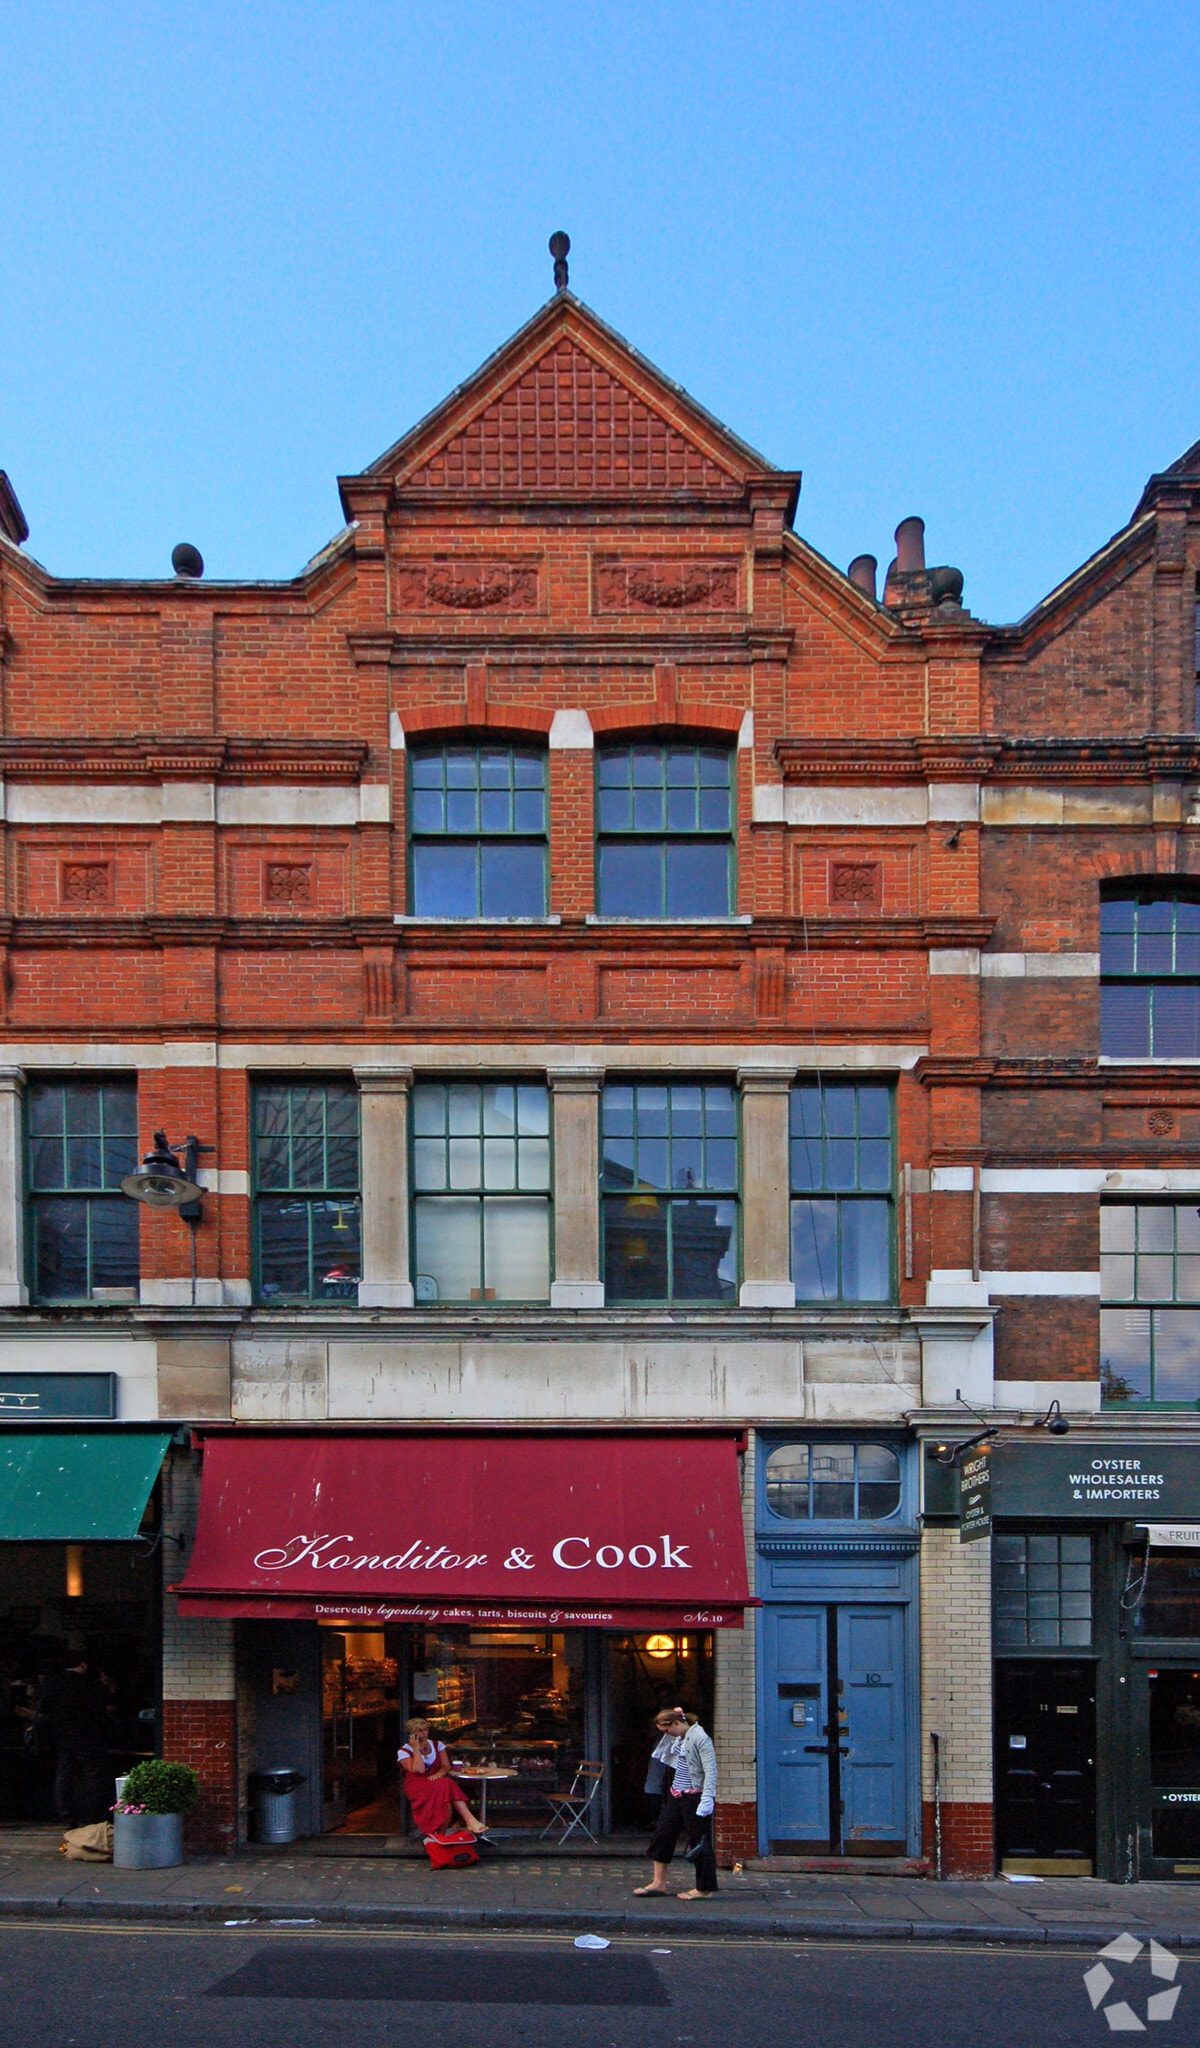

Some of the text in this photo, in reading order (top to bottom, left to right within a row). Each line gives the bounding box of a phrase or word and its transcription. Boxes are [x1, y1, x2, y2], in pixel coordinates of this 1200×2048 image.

[963, 1456, 987, 1476] WRIGHT
[1091, 1460, 1141, 1470] OYSTER
[961, 1470, 990, 1492] BROTHERS
[1069, 1474, 1164, 1485] WHOLESALERS
[1073, 1489, 1160, 1499] & IMPORTERS
[253, 1534, 693, 1571] Konditor & Cook
[315, 1604, 374, 1616] Deservedly
[376, 1603, 440, 1621] legendary
[507, 1609, 547, 1619] biscuits
[548, 1610, 564, 1623] &
[564, 1611, 613, 1620] savouries
[866, 1673, 882, 1684] 10
